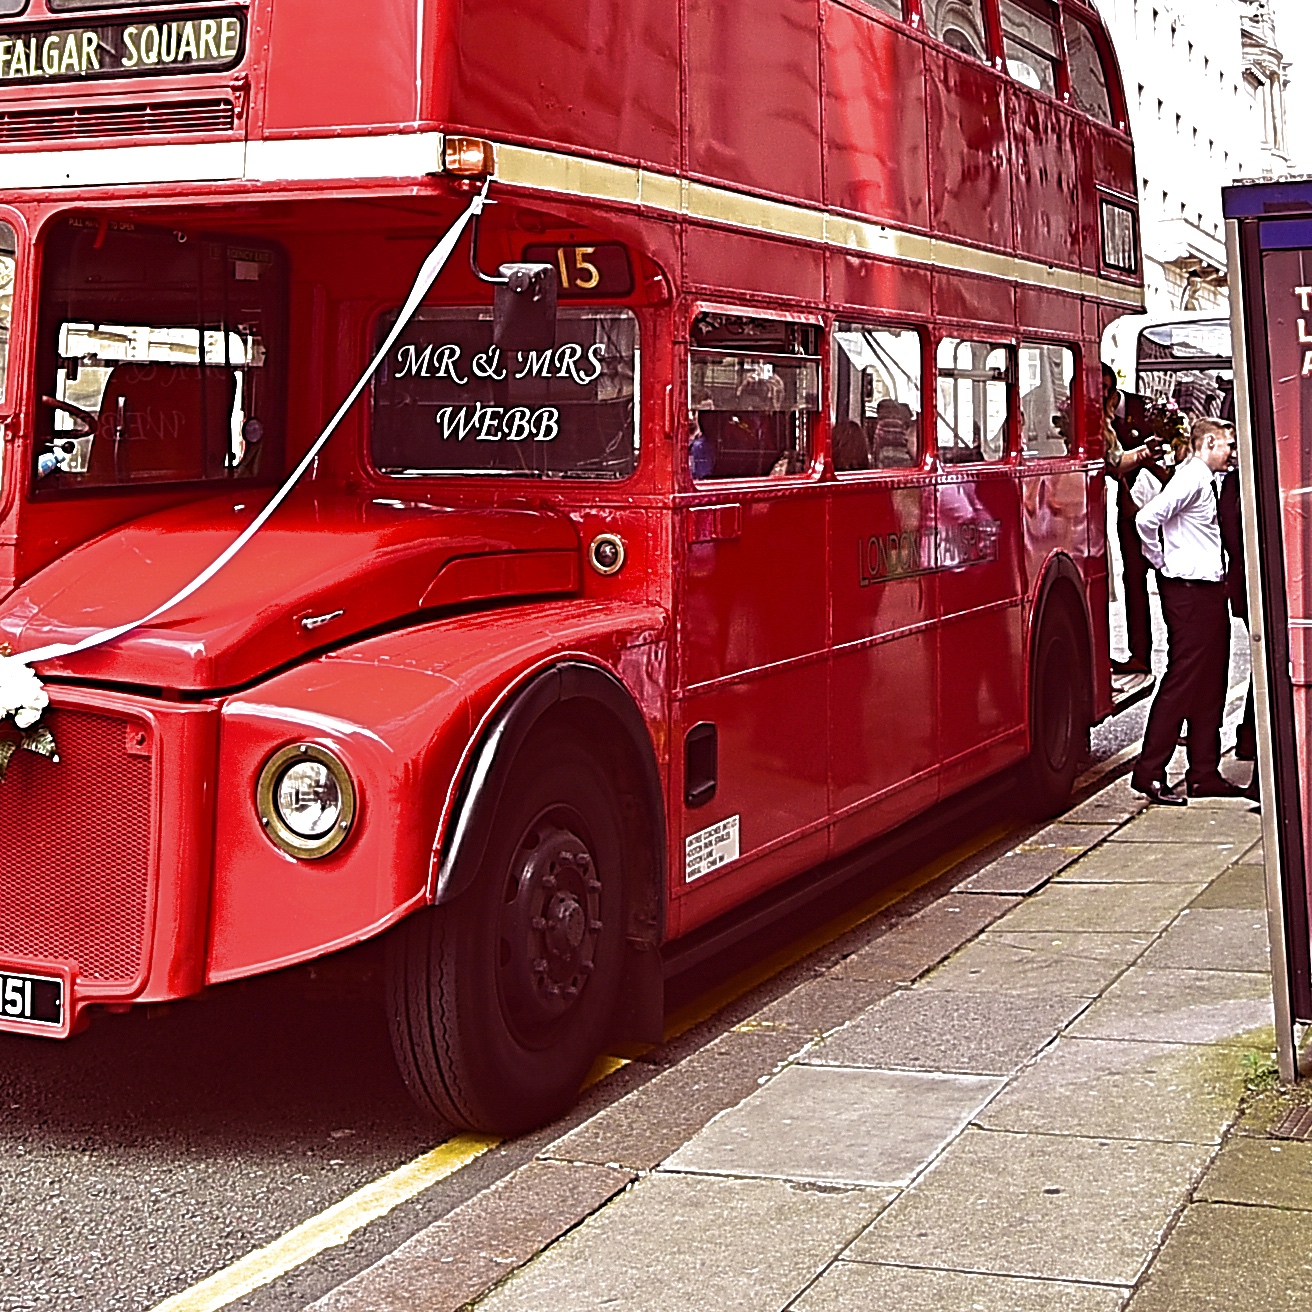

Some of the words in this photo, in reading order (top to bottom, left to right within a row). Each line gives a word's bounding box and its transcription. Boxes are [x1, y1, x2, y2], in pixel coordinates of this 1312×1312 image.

[121, 18, 238, 68] SQUARE
[557, 247, 599, 288] 15
[394, 344, 468, 384] MR
[472, 344, 507, 380] &
[515, 343, 606, 385] MRS
[436, 402, 560, 441] WEBB
[856, 530, 921, 585] LONDON
